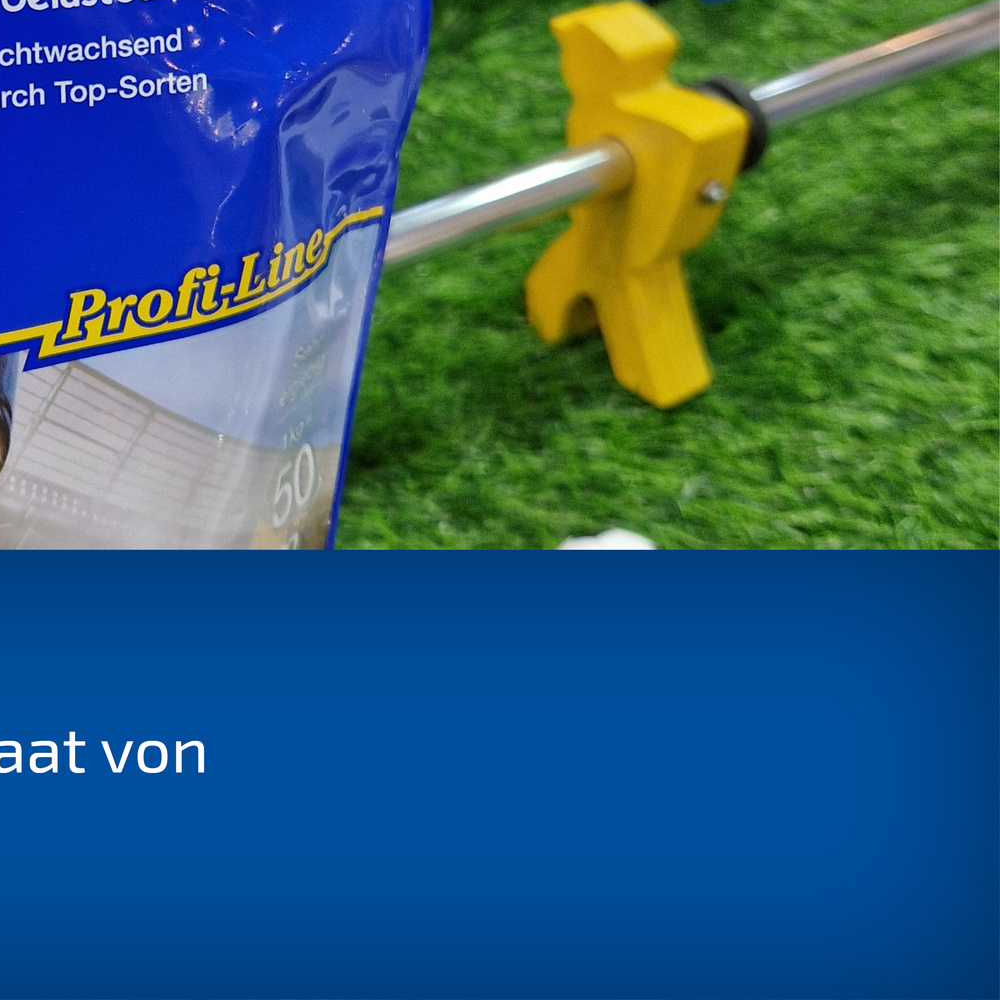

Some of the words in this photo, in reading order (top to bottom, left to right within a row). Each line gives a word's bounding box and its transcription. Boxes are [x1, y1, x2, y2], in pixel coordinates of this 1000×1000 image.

[54, 72, 208, 107] Top-Sorten
[62, 228, 325, 340] Profi-Line
[272, 443, 315, 530] 50
